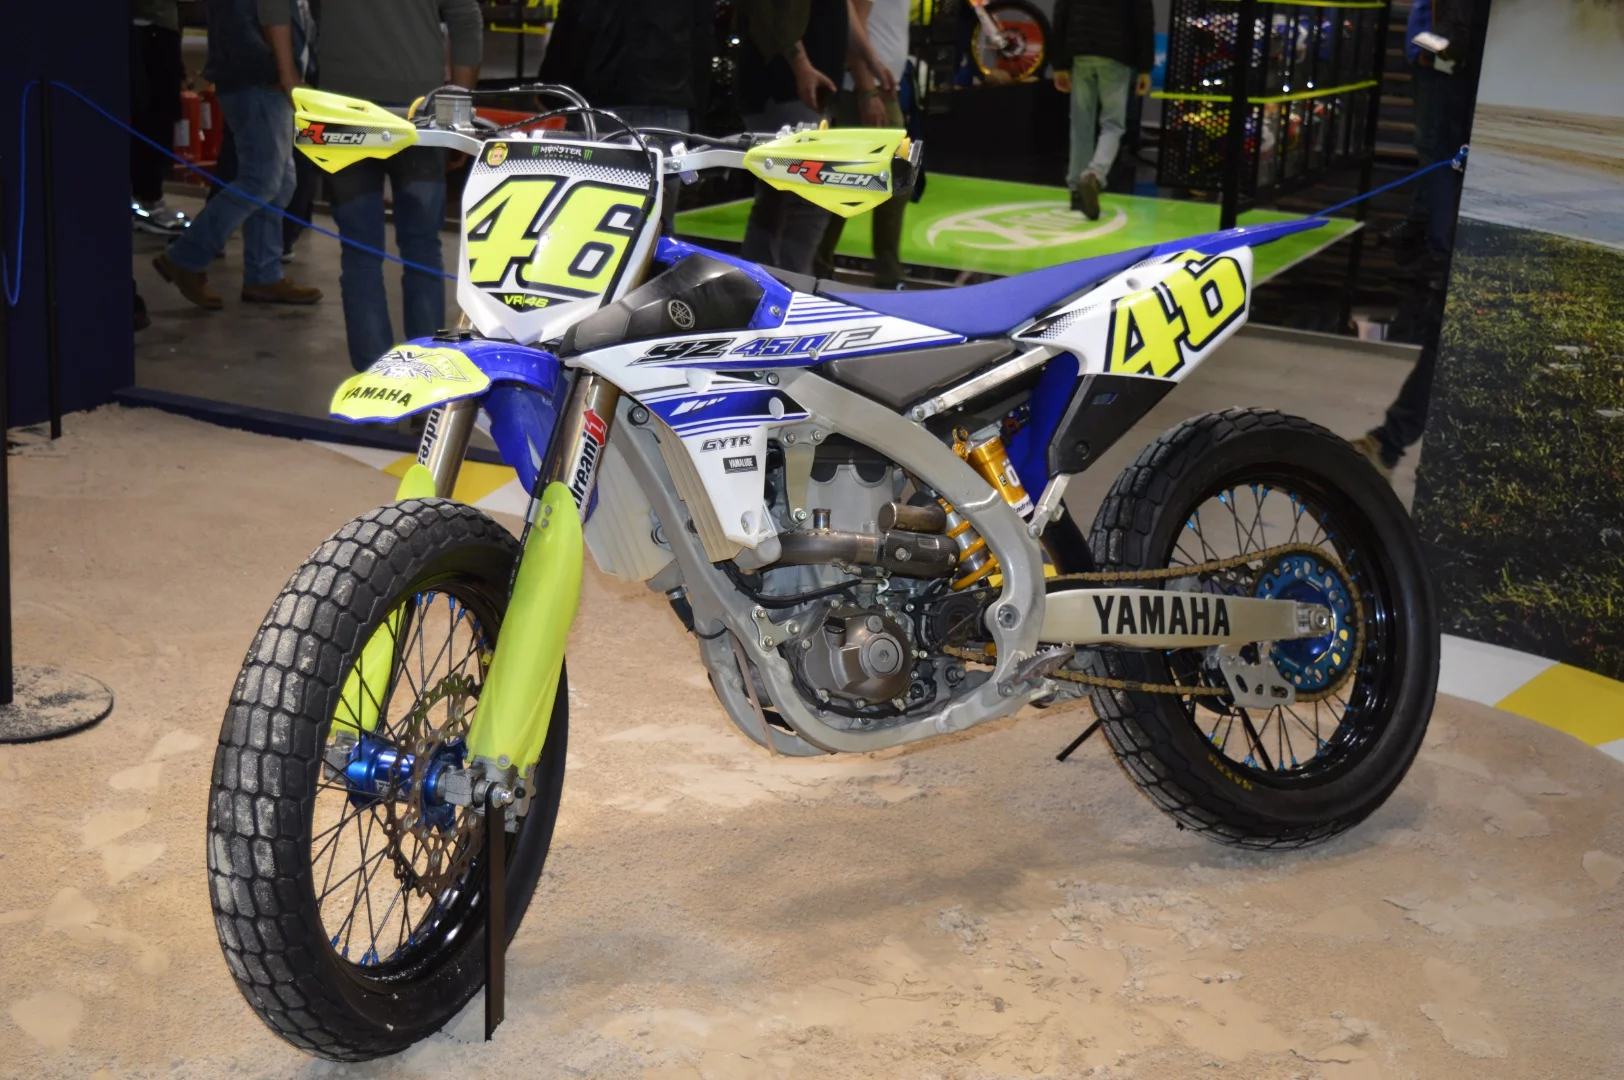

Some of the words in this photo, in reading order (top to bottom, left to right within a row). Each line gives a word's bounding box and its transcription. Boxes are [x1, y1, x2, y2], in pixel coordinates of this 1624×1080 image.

[540, 145, 582, 157] MONSTER
[465, 174, 655, 298] 46
[1103, 249, 1246, 379] 46
[342, 386, 413, 408] YAMAHA
[700, 434, 753, 453] GYTR
[728, 457, 754, 469] YAMALUBE
[1092, 595, 1231, 637] YAMAHA
